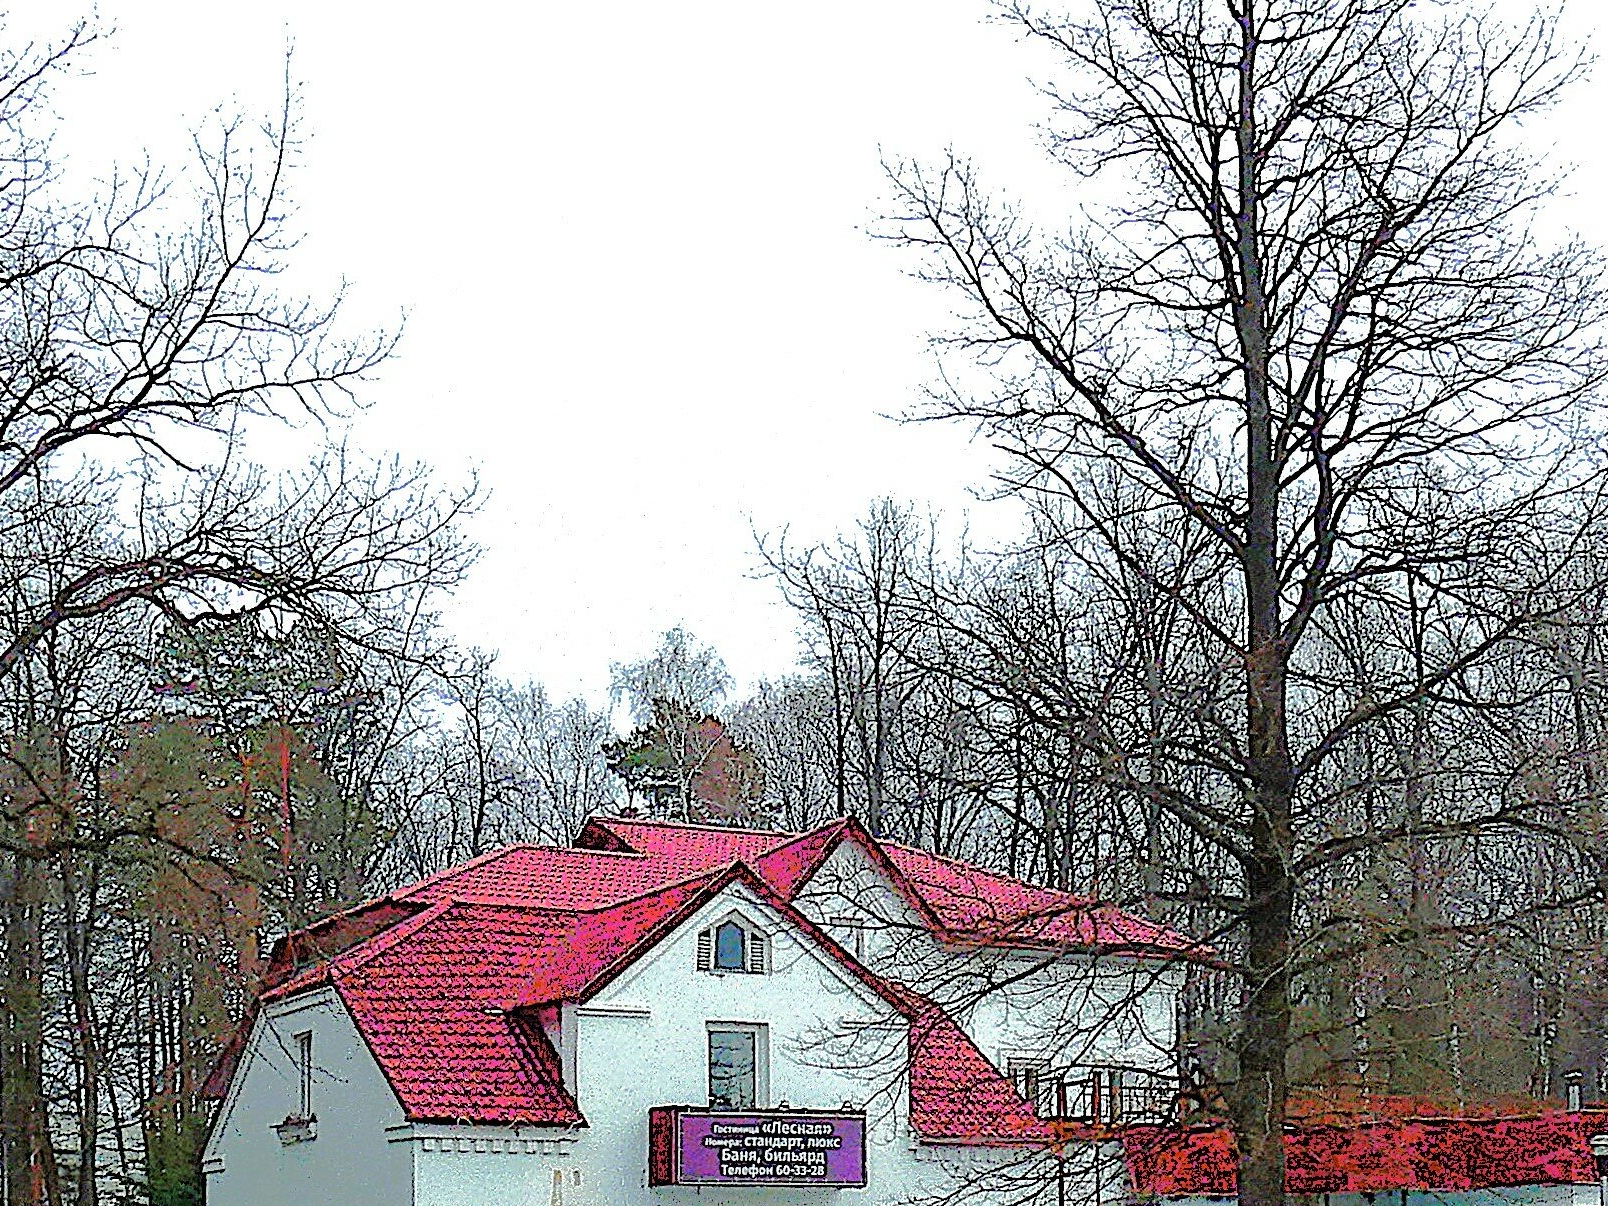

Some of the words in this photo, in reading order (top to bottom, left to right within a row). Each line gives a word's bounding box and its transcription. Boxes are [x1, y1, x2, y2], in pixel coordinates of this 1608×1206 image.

[713, 1124, 759, 1135] Гостиница
[762, 1120, 832, 1135] «Лесная»
[744, 1136, 805, 1150] стандарт,
[807, 1137, 841, 1149] люкс
[721, 1148, 761, 1164] Баня,
[764, 1147, 825, 1165] бильярд
[720, 1164, 773, 1178] Телефон
[775, 1164, 825, 1176] 60-33-28
